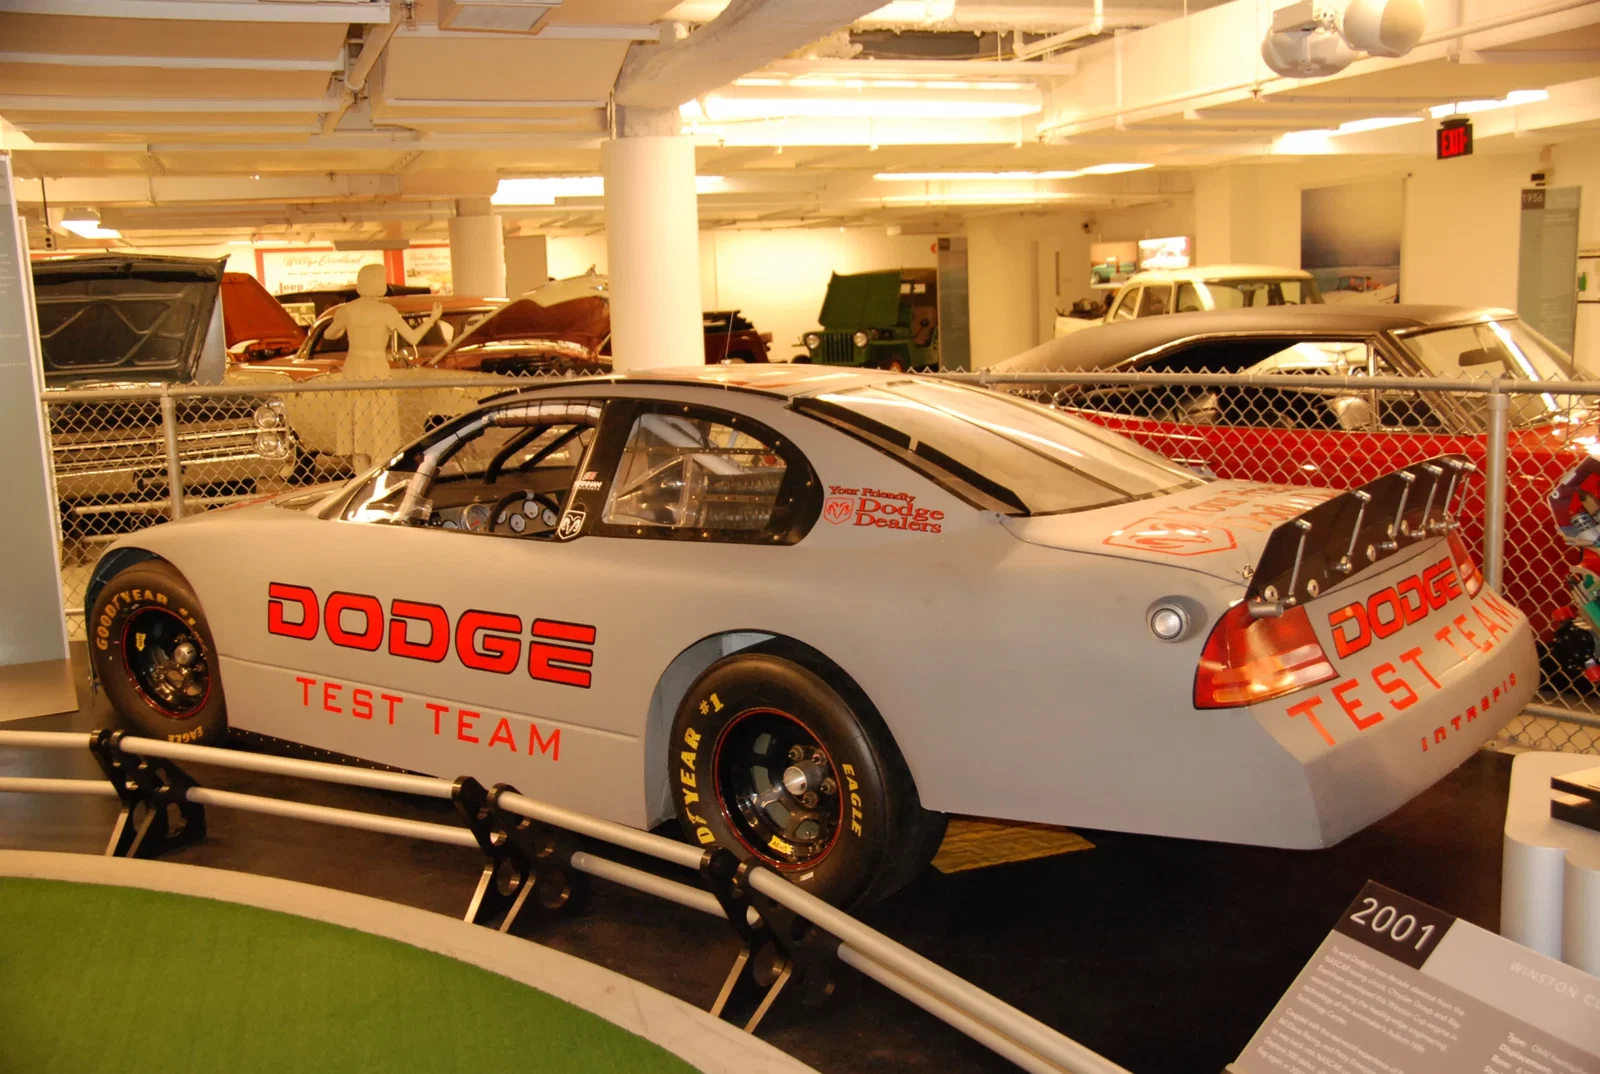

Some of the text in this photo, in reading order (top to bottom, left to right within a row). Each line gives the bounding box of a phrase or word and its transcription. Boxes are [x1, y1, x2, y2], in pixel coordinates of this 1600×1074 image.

[1441, 126, 1466, 157] EXIT
[829, 485, 917, 503] Your Friendly
[853, 512, 942, 533] Dealers
[856, 497, 945, 522] Dodge
[97, 589, 168, 651] GOODYEAR
[268, 582, 597, 689] DODGE
[1328, 557, 1462, 660] DODGE
[1286, 592, 1519, 747] TEST TEAM
[296, 677, 562, 762] TEST TEAM
[681, 693, 725, 845] DYEAR #1
[842, 763, 863, 837] EAGLE
[1350, 897, 1435, 951] 2001
[1510, 961, 1579, 998] WINSTON
